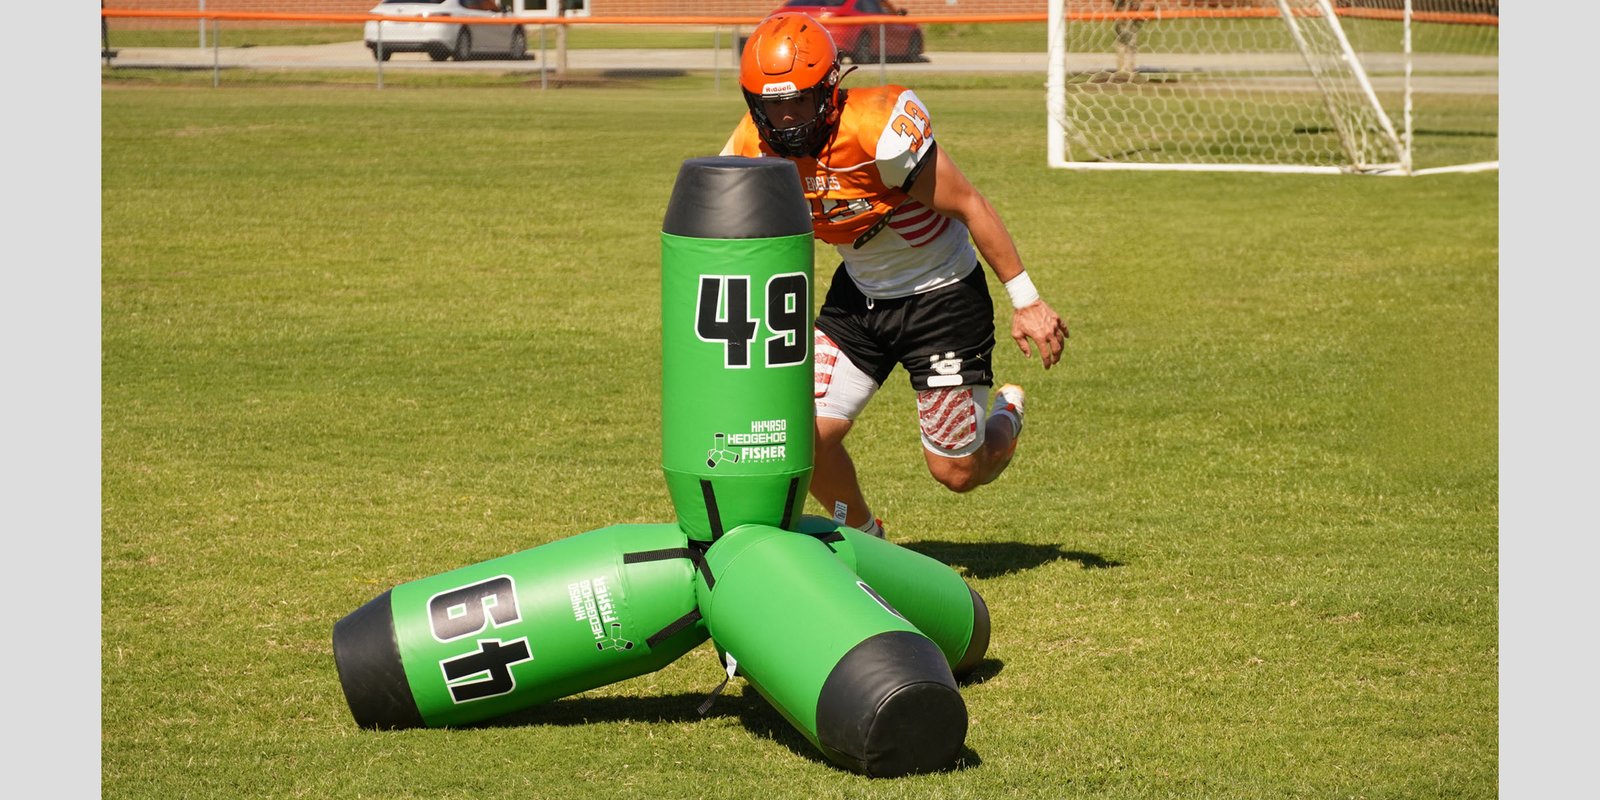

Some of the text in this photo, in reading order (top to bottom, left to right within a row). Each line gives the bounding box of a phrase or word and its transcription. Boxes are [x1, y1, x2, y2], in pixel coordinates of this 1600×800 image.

[891, 100, 933, 153] 33
[694, 271, 809, 369] 49
[727, 432, 787, 445] HEDGEHOG
[741, 445, 786, 460] FISHER
[580, 579, 605, 640] HEDGEHOG
[593, 575, 616, 623] FISHER
[426, 574, 534, 704] 49
